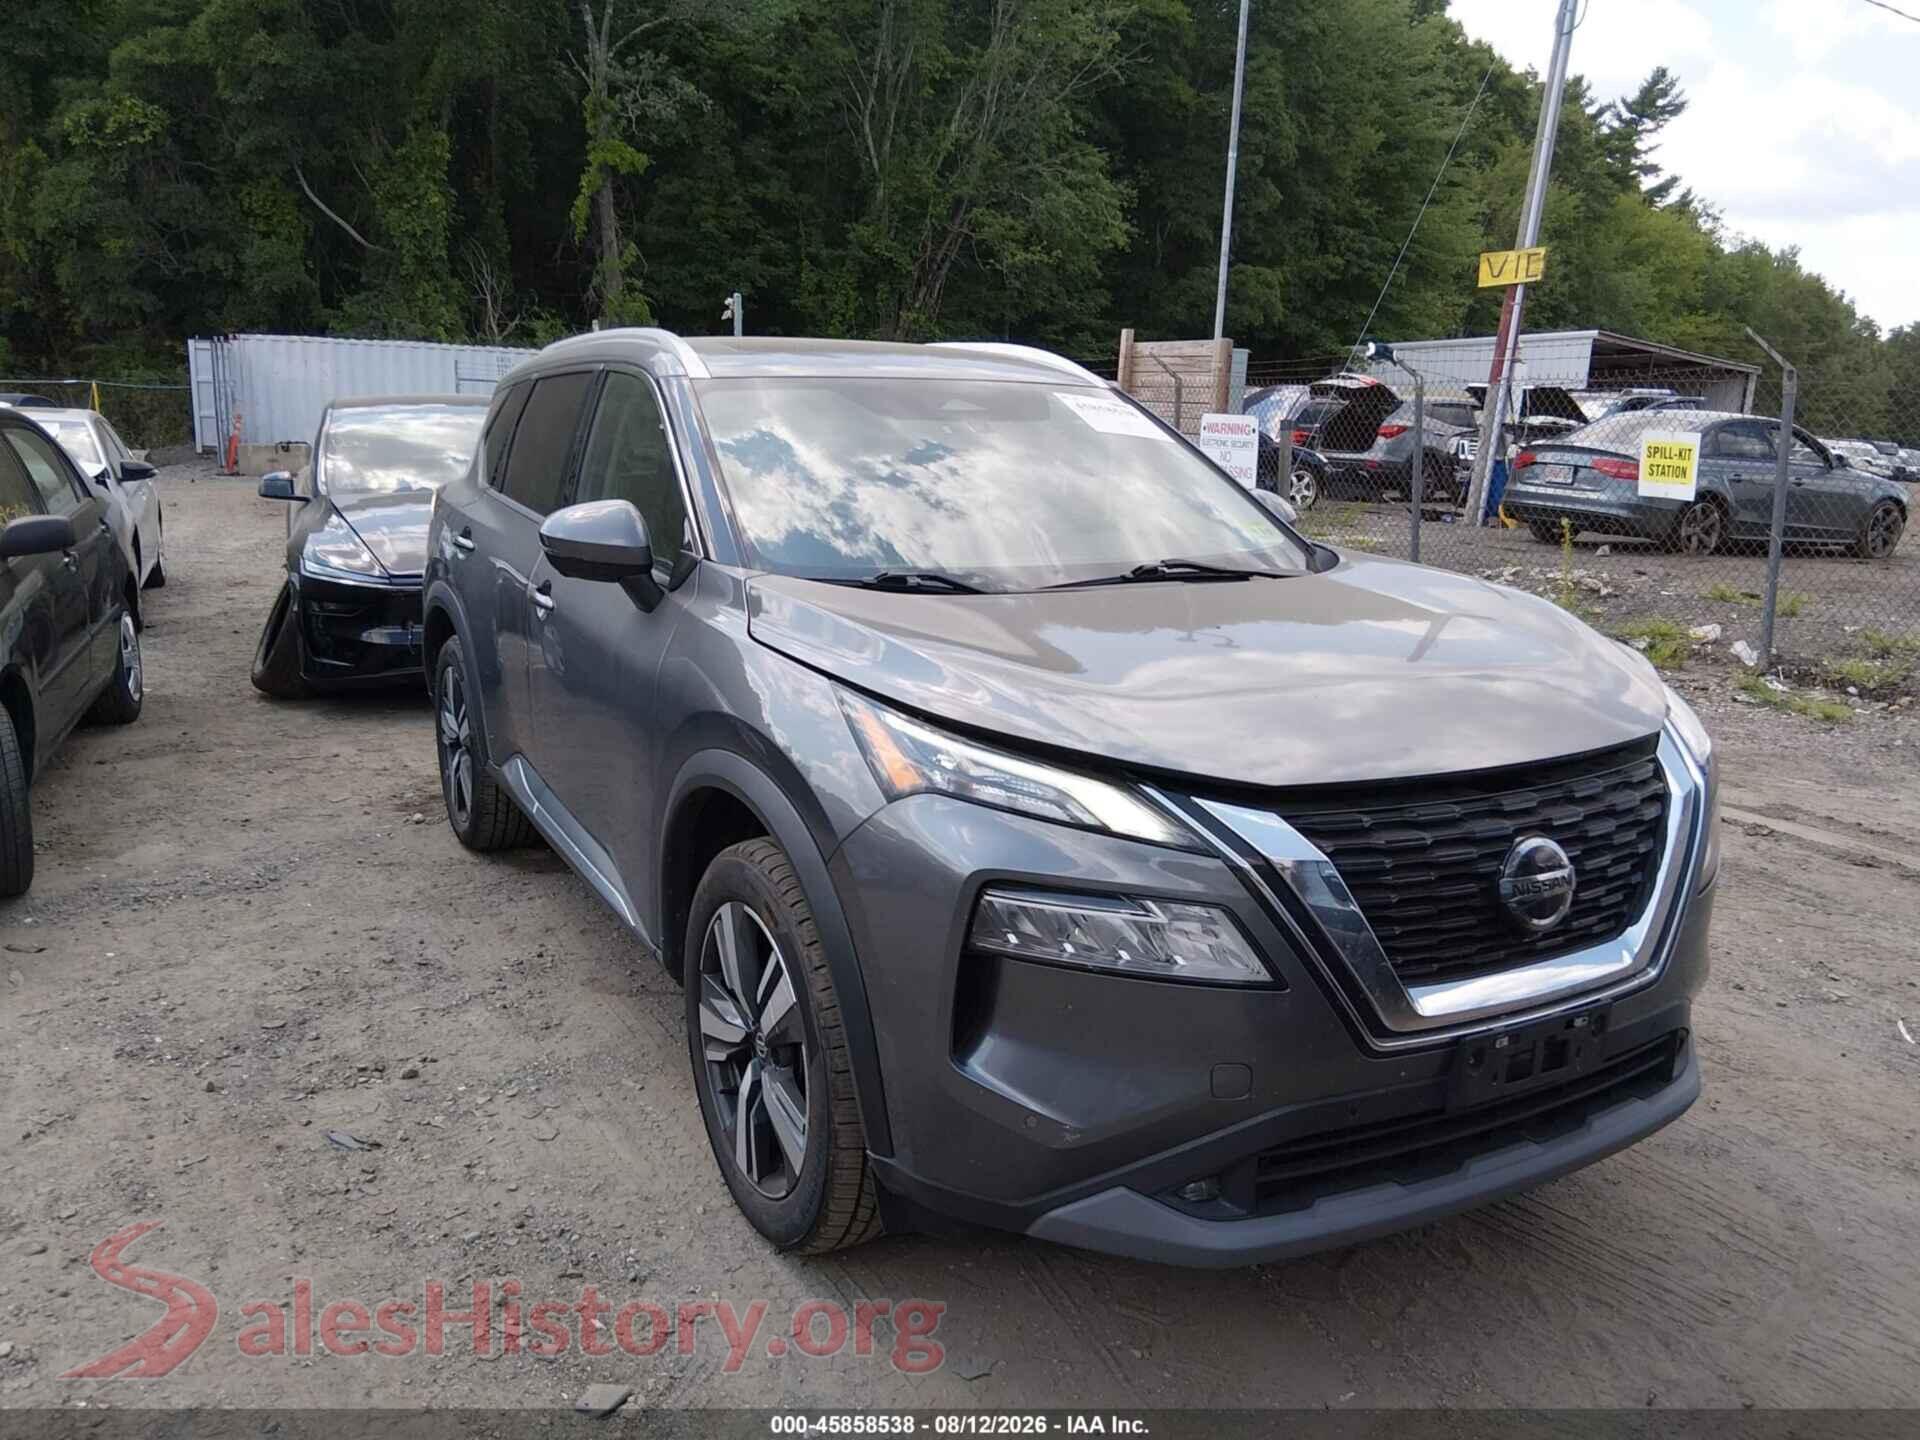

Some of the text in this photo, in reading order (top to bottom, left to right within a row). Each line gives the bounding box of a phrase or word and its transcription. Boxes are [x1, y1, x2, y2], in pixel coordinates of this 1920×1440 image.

[1207, 422, 1251, 436] WARNING
[1219, 450, 1231, 462] NO
[1646, 445, 1693, 461] SPILL-KIT
[1648, 463, 1688, 479] STATION
[1512, 875, 1568, 896] NISSAN
